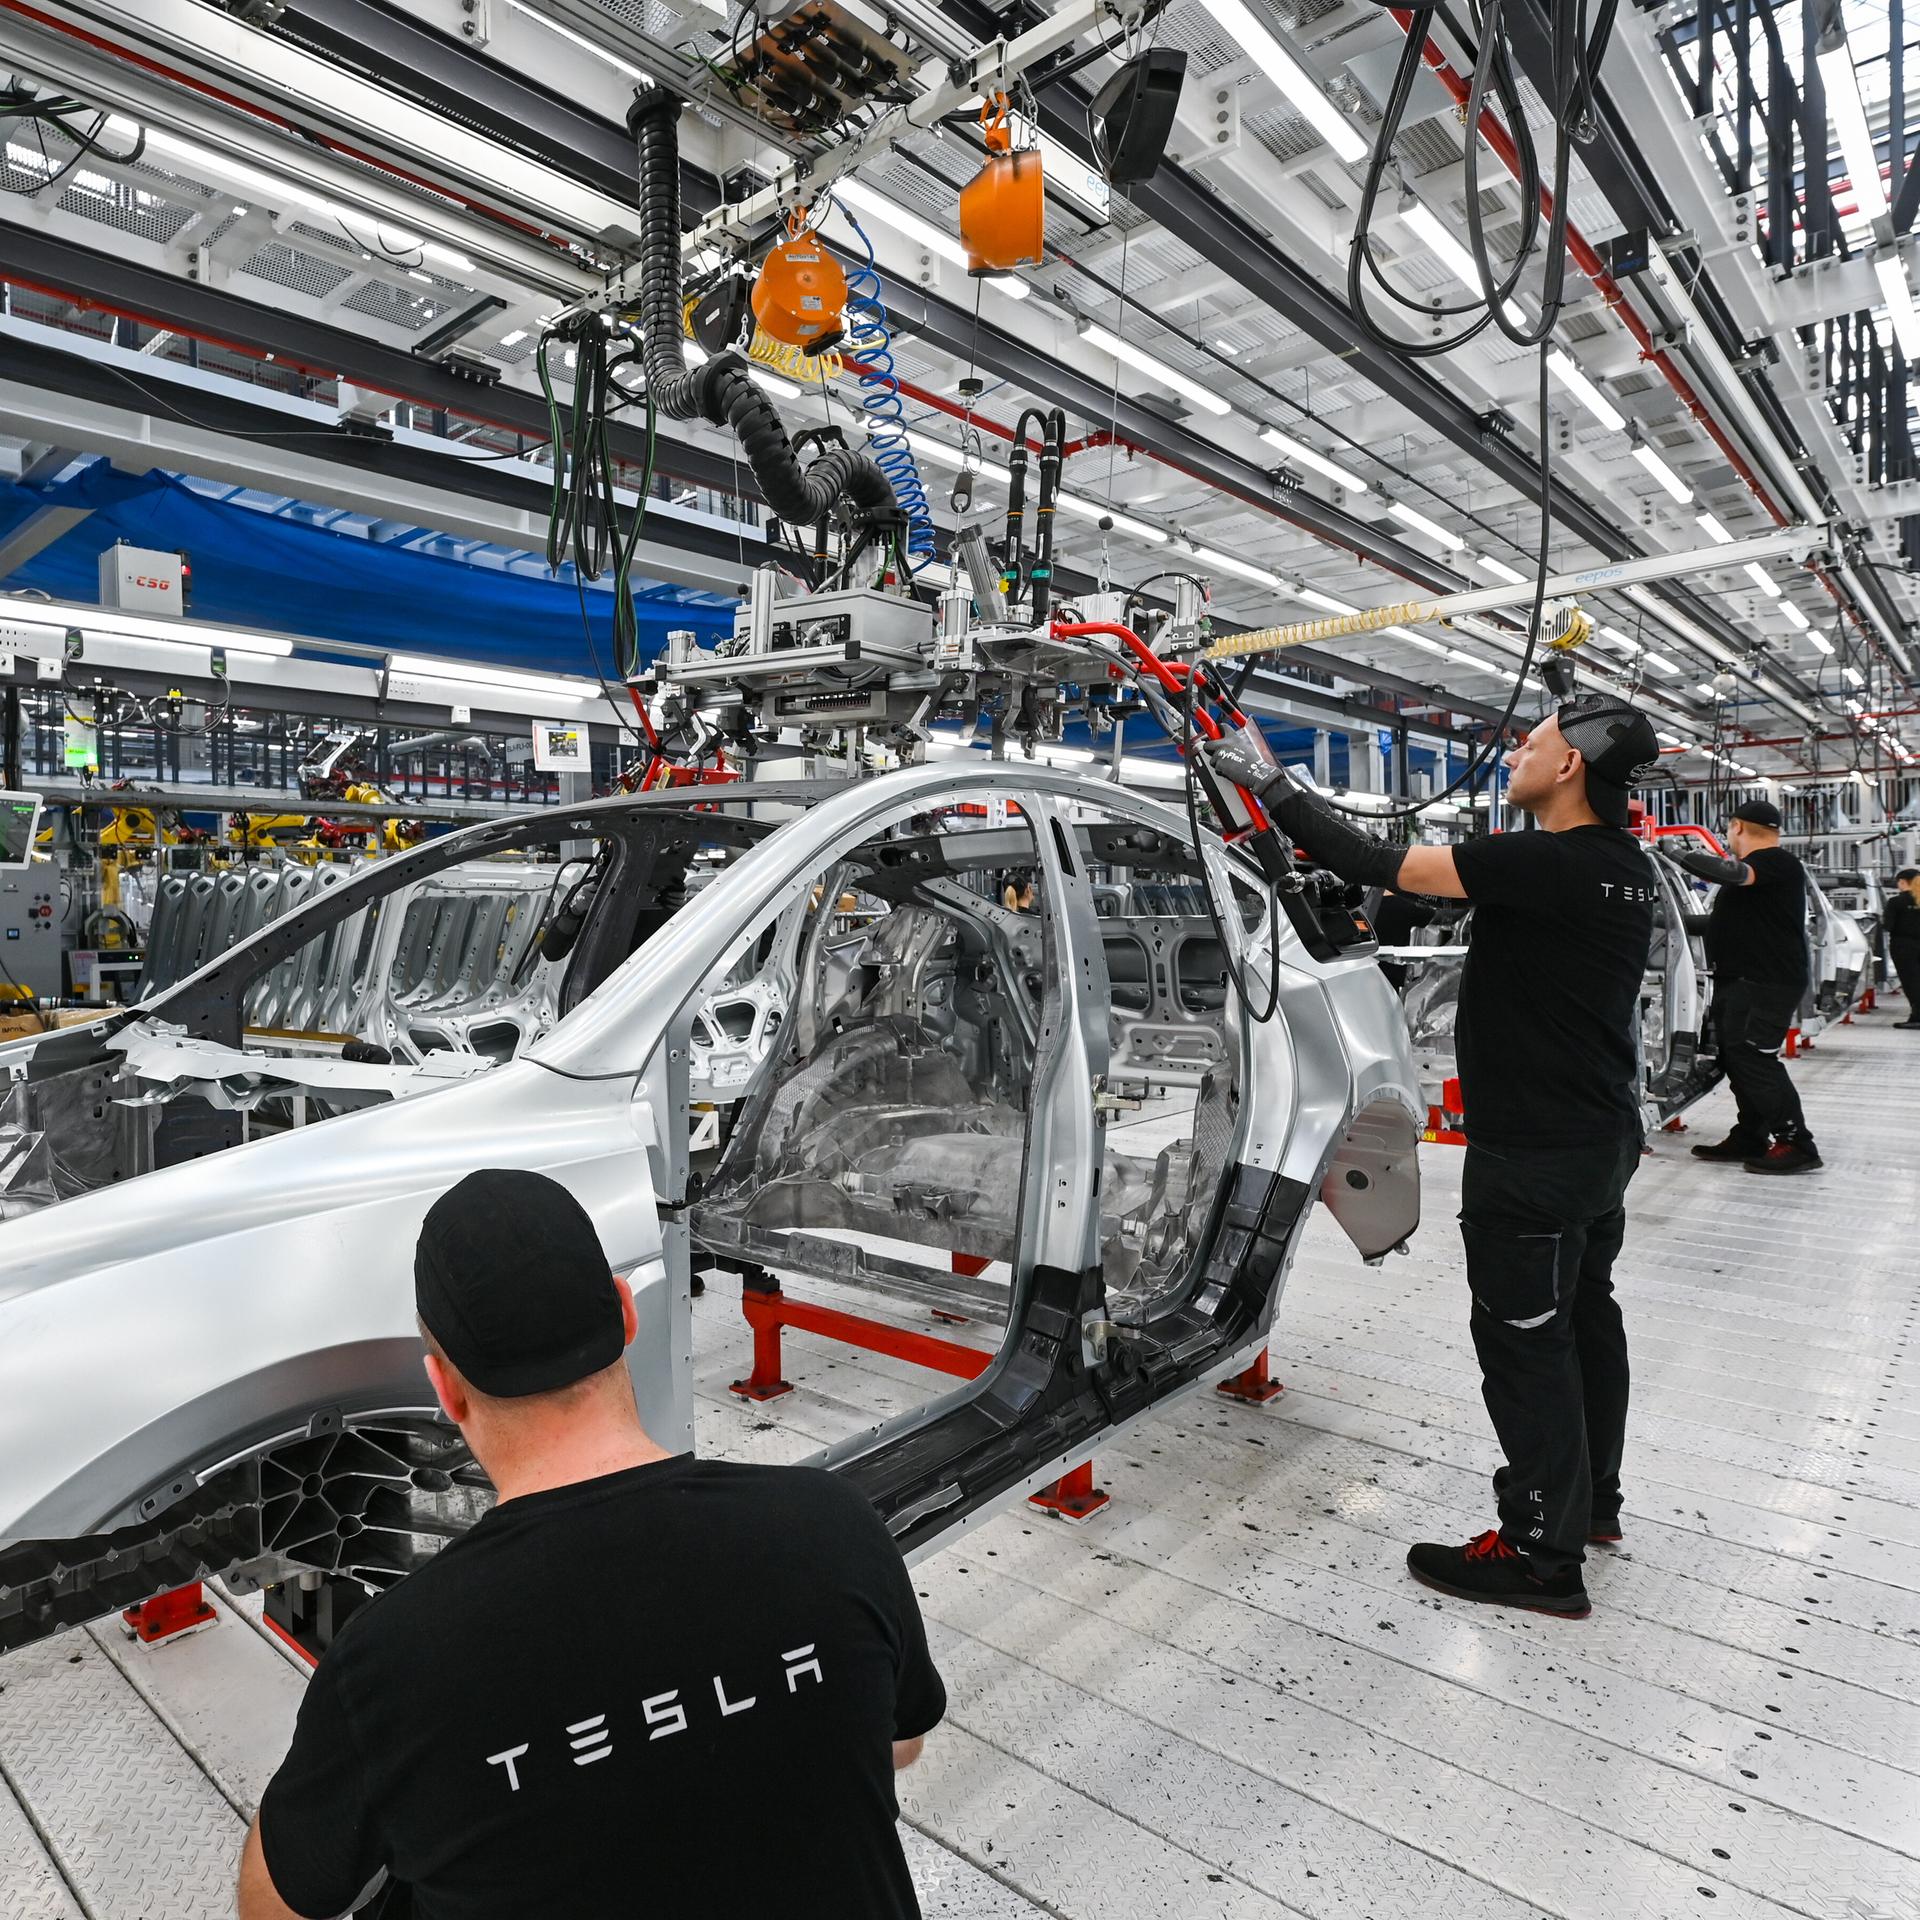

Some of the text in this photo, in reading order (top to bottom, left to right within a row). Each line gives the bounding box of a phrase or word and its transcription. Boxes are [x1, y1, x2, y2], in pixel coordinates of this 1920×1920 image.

[136, 575, 170, 590] CSG
[1575, 567, 1623, 584] eepos
[486, 1643, 823, 1792] TESLA
